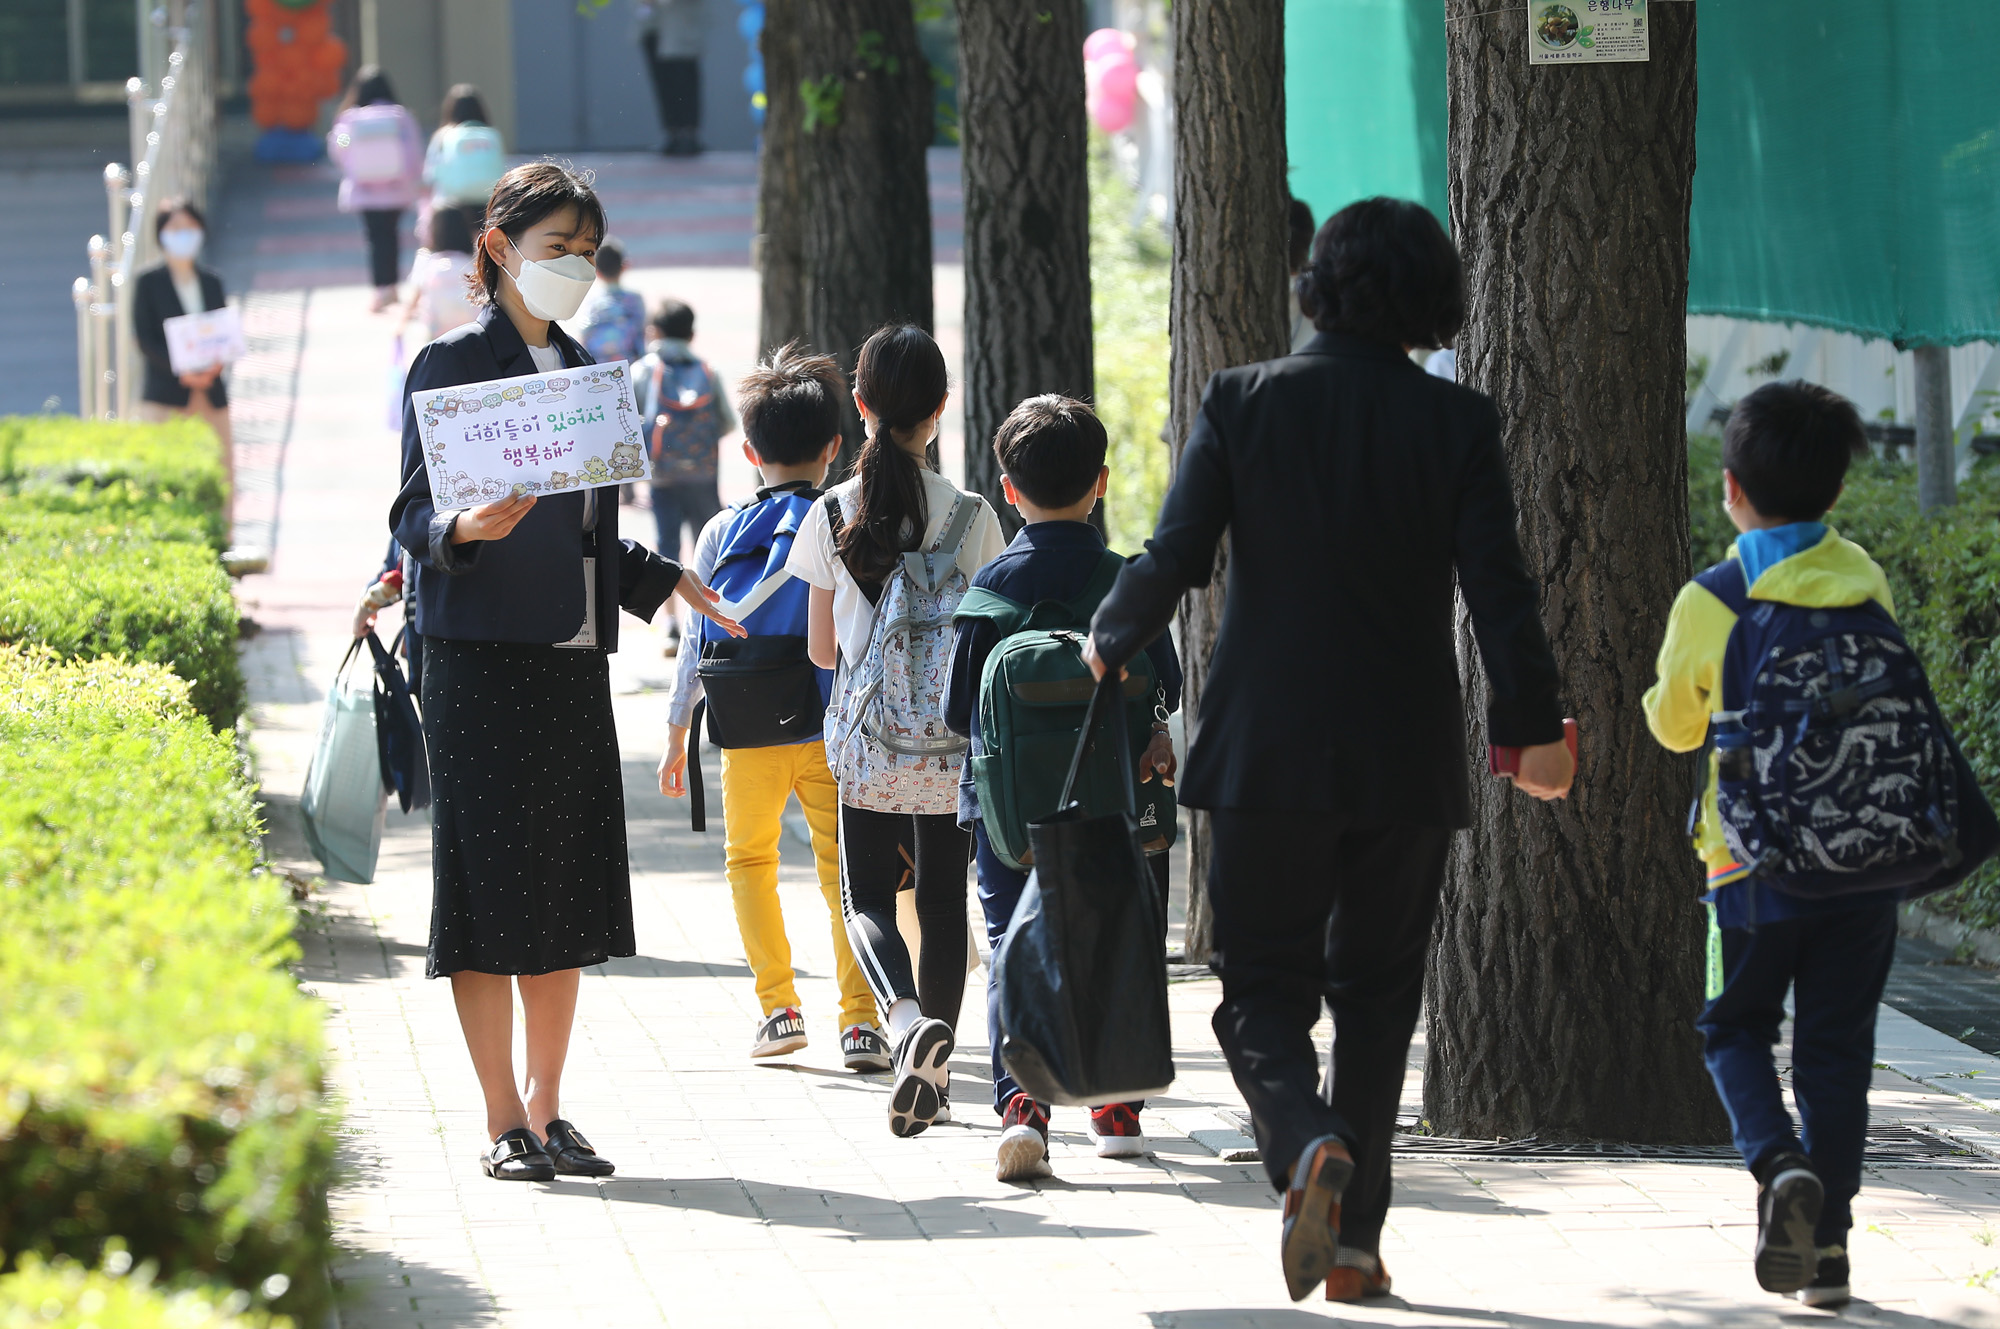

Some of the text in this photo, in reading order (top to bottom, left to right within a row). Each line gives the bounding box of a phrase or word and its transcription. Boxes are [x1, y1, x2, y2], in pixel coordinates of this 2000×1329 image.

[463, 405, 605, 442] 너희들이 있어서
[775, 1018, 804, 1036] NIKE
[843, 1036, 872, 1052] NIKE
